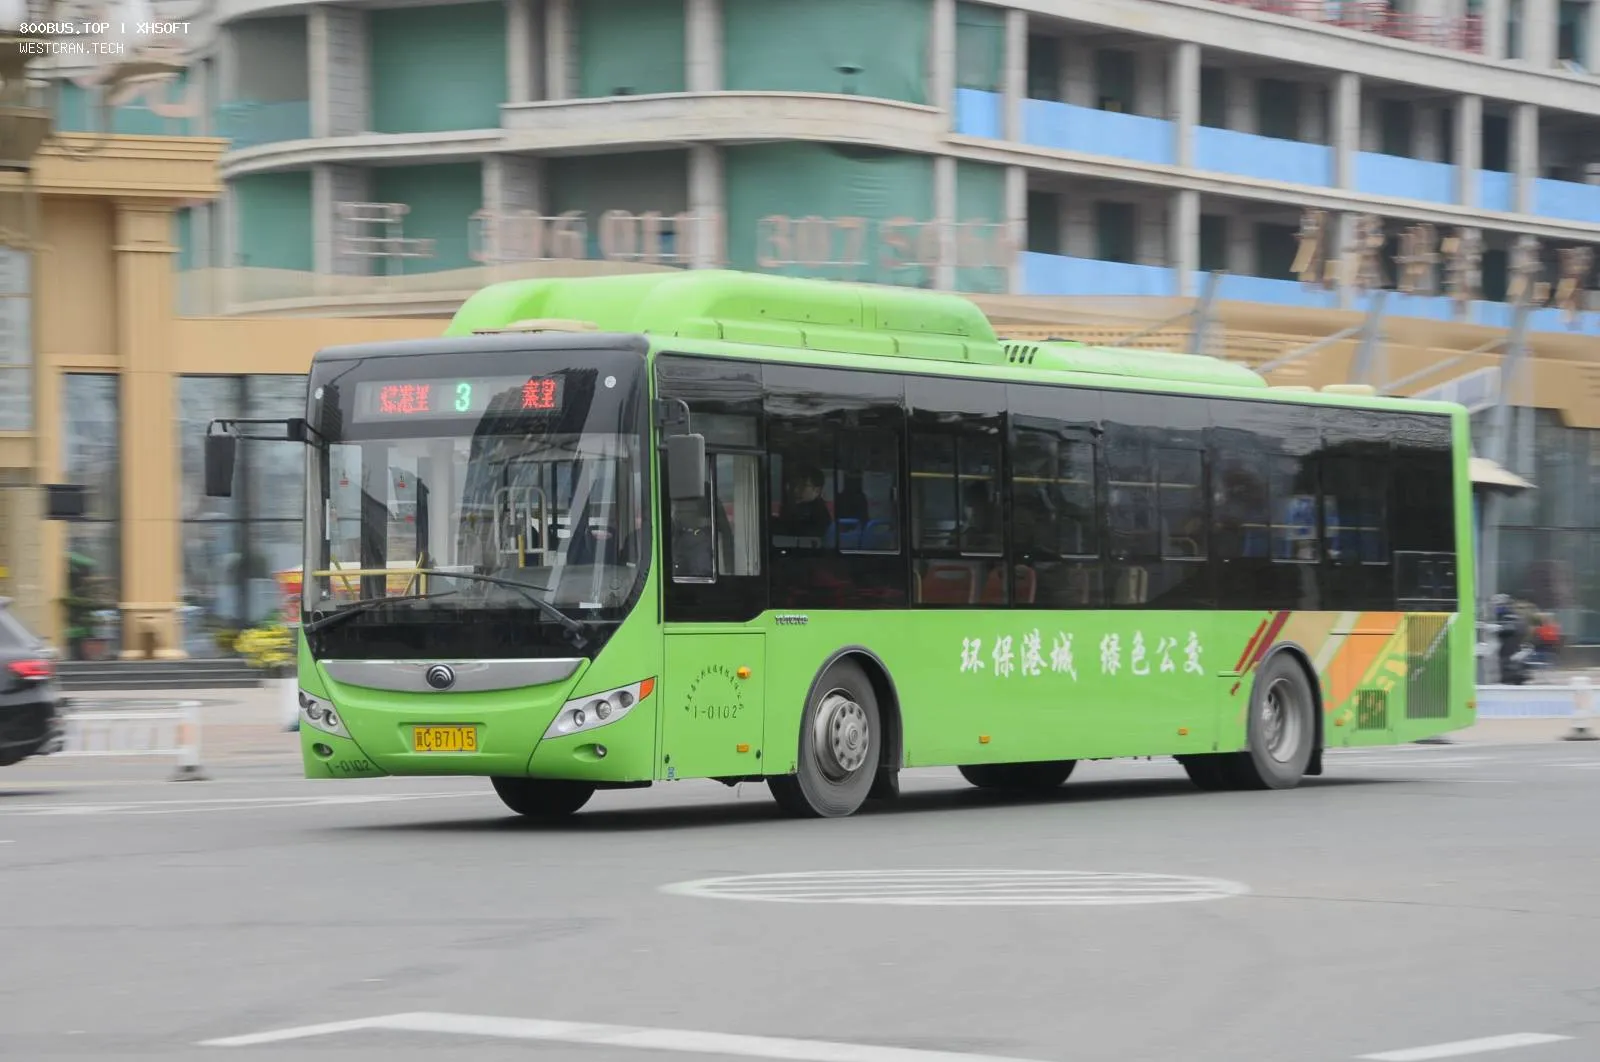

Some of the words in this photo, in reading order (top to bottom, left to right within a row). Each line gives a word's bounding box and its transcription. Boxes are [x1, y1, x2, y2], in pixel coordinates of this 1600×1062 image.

[455, 383, 472, 412] 3
[960, 628, 1077, 682] 环保港城
[1099, 630, 1205, 676] 绿色公交
[693, 704, 739, 720] 1-0102
